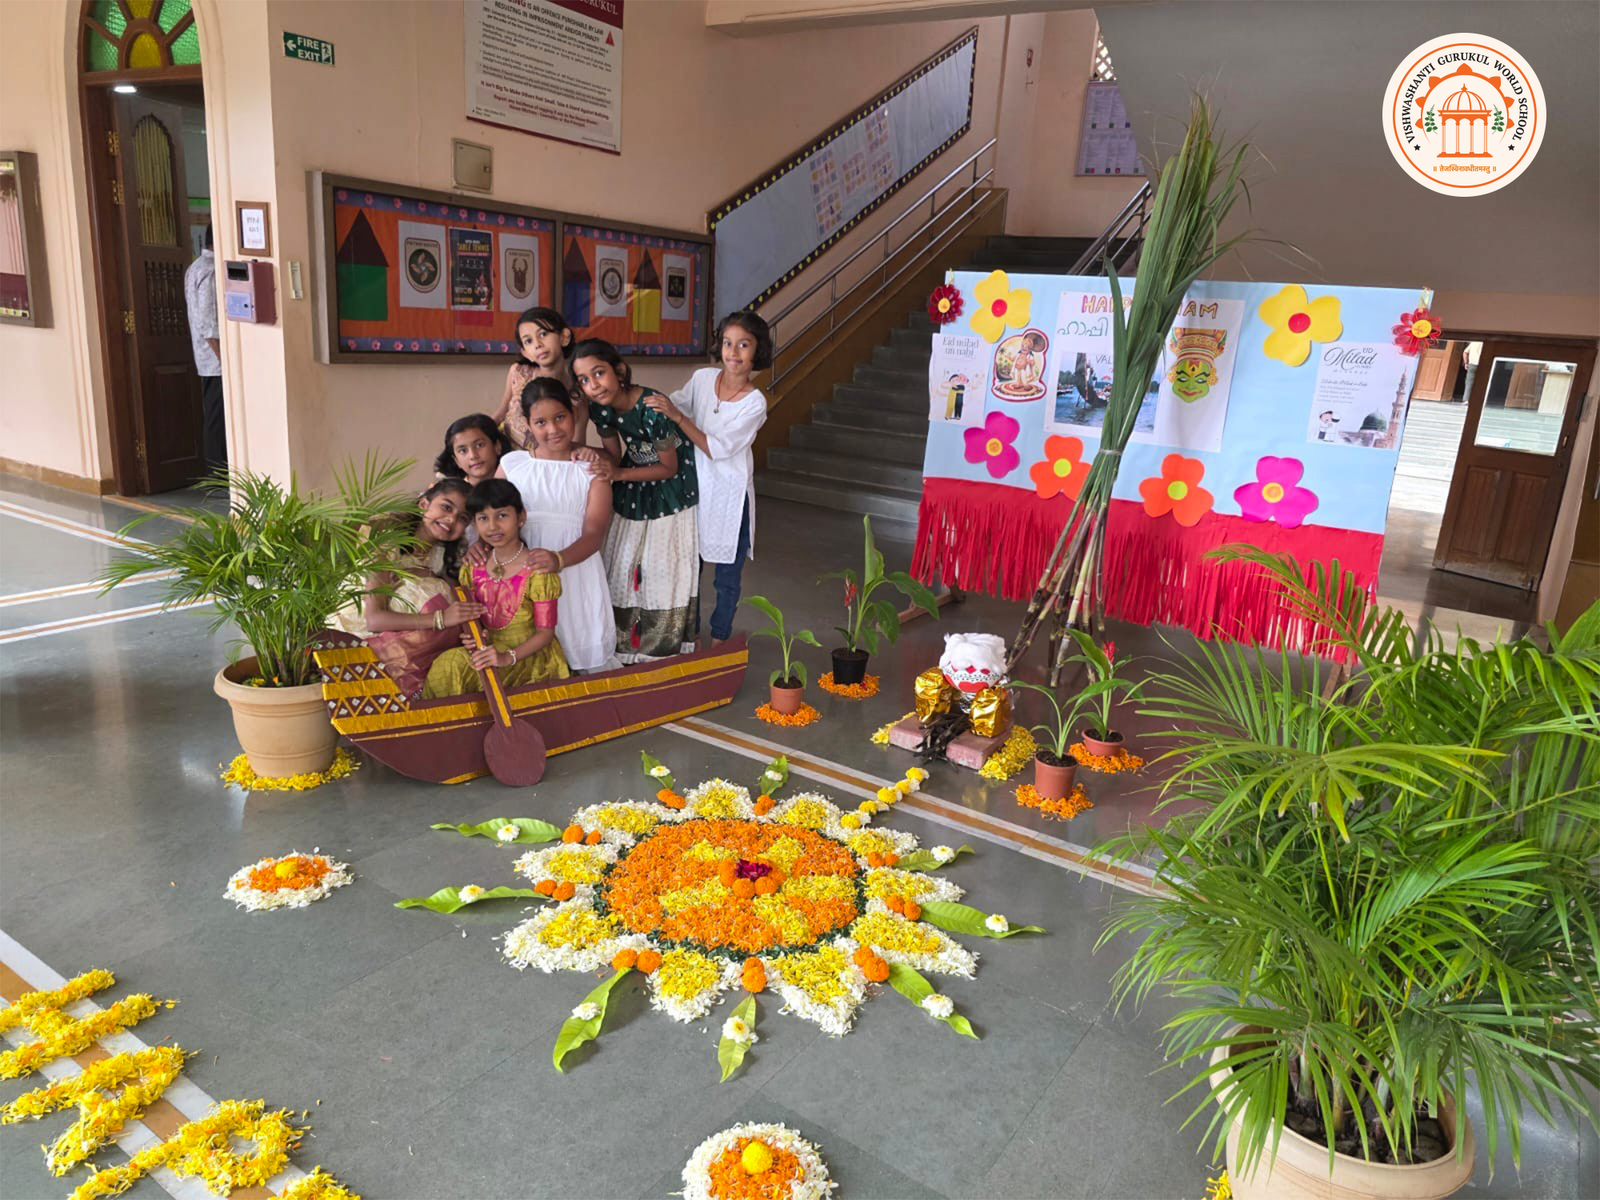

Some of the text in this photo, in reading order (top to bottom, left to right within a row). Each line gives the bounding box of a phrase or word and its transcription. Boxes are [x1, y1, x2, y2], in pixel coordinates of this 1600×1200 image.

[580, 0, 619, 15] RUKUL
[297, 36, 320, 50] FIRE
[298, 49, 321, 62] EXIT
[1095, 354, 1113, 365] VAL
[1323, 346, 1378, 371] Milad
[0, 968, 360, 1200] HAP
